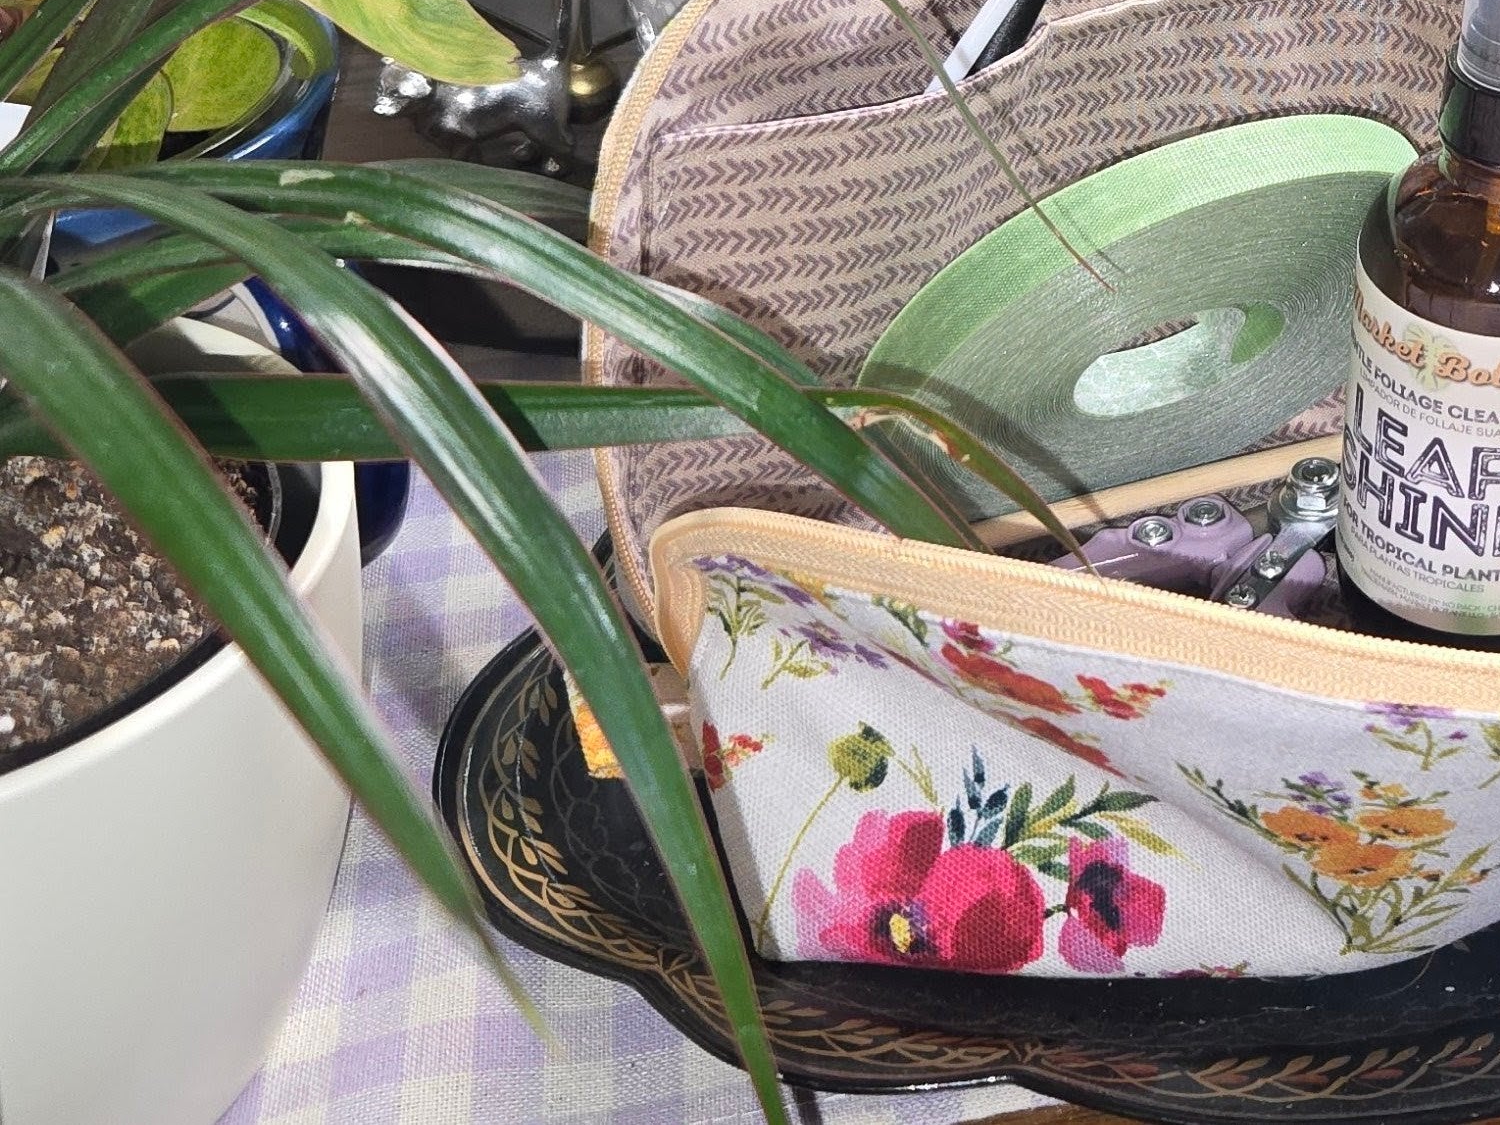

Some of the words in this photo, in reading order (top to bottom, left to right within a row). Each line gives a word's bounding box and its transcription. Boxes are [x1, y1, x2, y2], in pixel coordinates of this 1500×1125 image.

[1374, 365, 1444, 415] FOLIAGE
[1402, 401, 1418, 418] DE
[1419, 413, 1472, 436] FOLLAJE
[1343, 495, 1359, 527] FOR
[1360, 519, 1437, 574] TROPICAL
[1369, 545, 1411, 577] PLANTAS
[1413, 570, 1485, 593] TROPICALES
